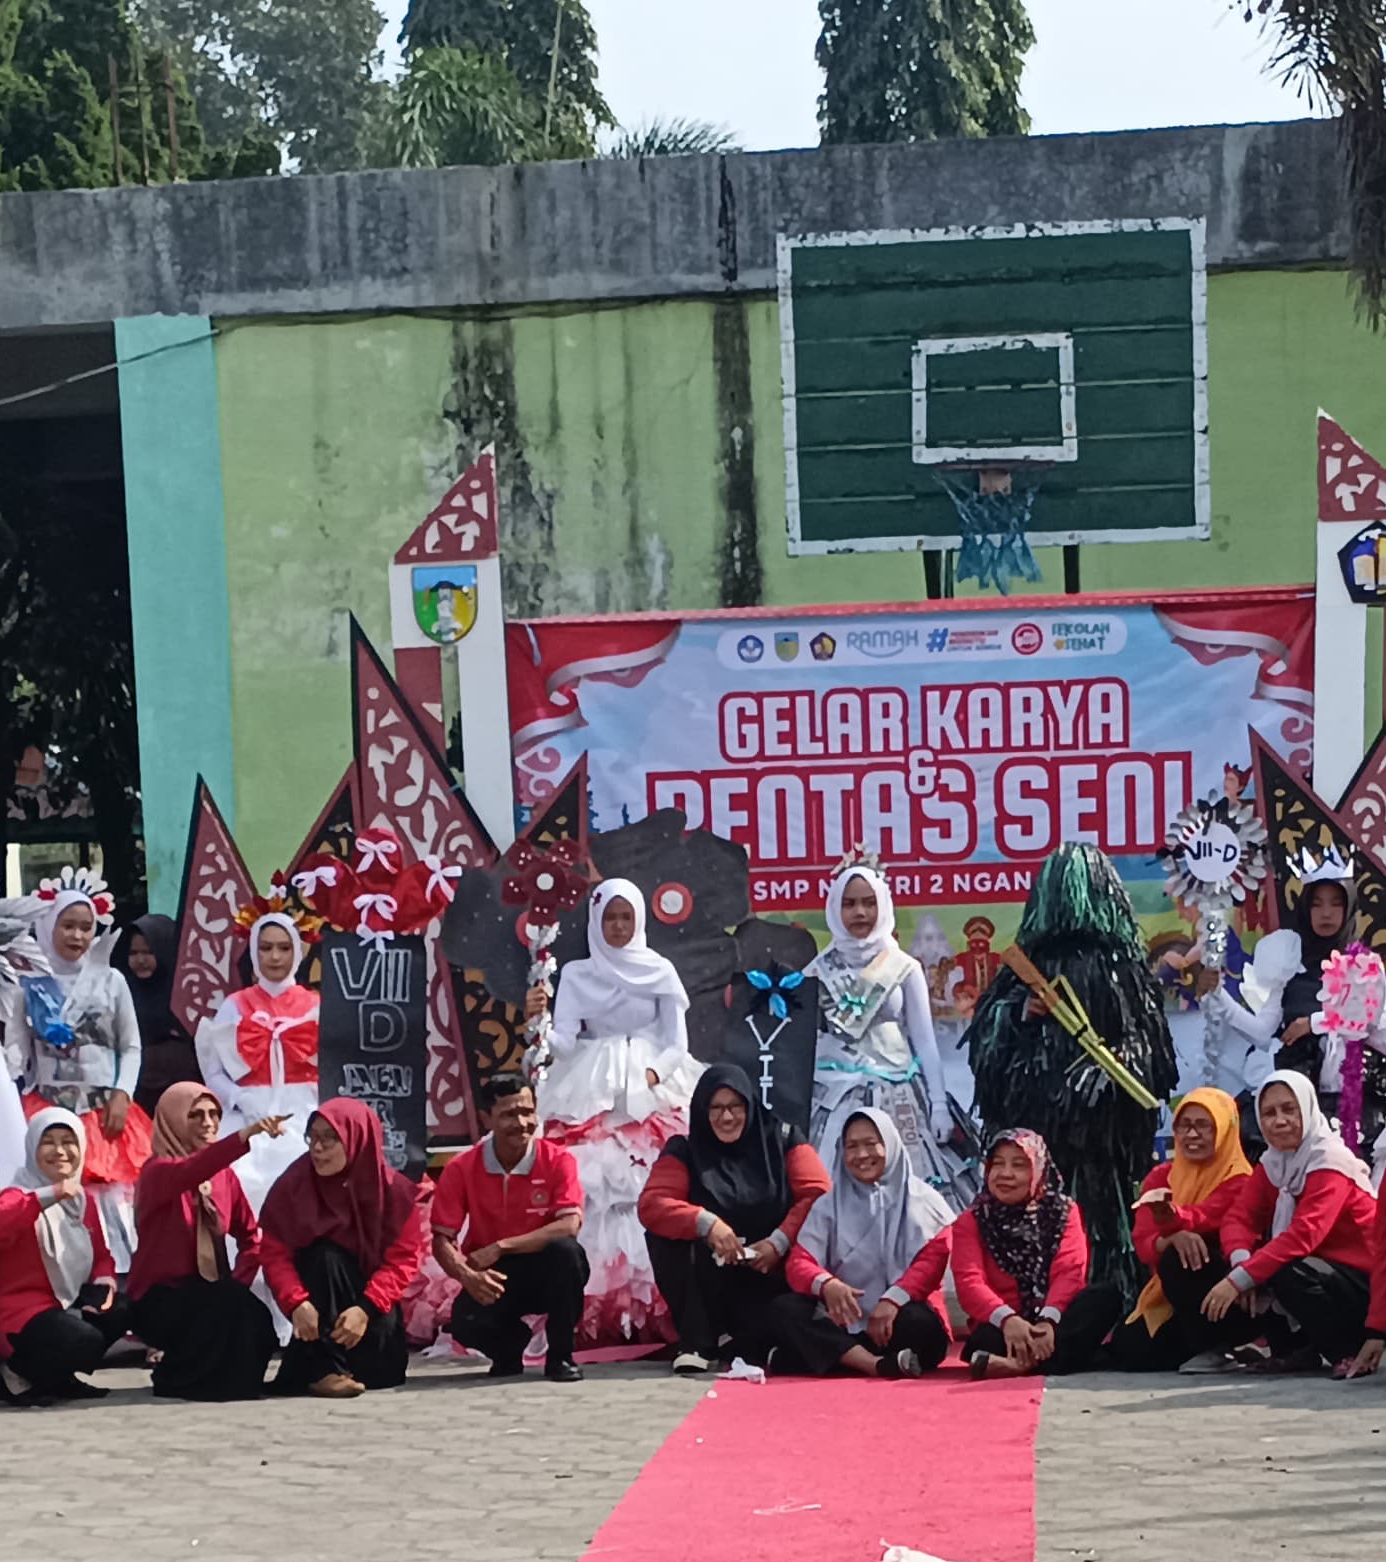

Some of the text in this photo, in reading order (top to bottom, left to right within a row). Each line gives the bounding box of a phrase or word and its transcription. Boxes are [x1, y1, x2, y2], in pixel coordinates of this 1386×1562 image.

[847, 630, 919, 652] RAMAH
[723, 683, 1124, 758] GELAR KARYA
[911, 751, 936, 793] &
[1001, 760, 1184, 853] SENI
[753, 880, 810, 901] SMP
[819, 874, 920, 898] NRI
[930, 874, 943, 894] 2
[331, 948, 412, 1002] VIII
[359, 1001, 407, 1052] D
